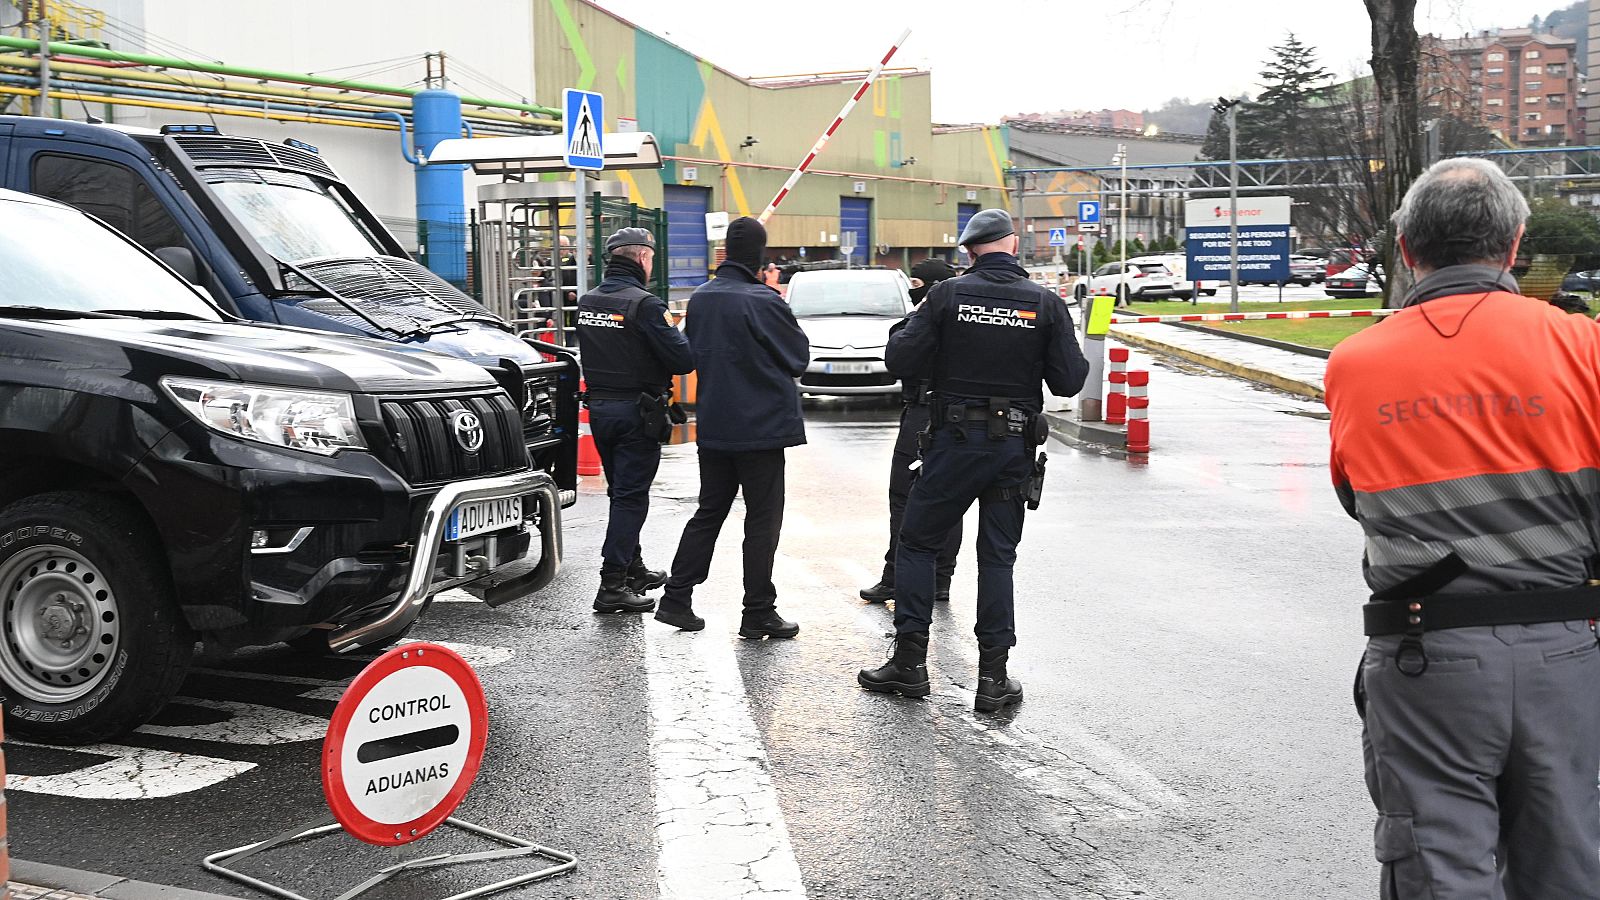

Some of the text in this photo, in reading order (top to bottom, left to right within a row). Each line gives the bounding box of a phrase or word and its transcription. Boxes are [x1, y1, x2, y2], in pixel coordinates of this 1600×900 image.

[1082, 204, 1096, 220] P
[1223, 208, 1261, 216] sienor
[579, 311, 613, 320] POLICIA
[957, 313, 1036, 329] NACIONAL
[958, 304, 1020, 318] POLICIA
[577, 318, 624, 329] NACIONAL
[1378, 394, 1545, 425] SECURITAS
[461, 497, 519, 533] ADUANAS
[0, 525, 84, 549] OOPER
[10, 649, 129, 723] DISCOVERER
[369, 694, 451, 724] CONTROL
[365, 762, 449, 796] ADUANAS
